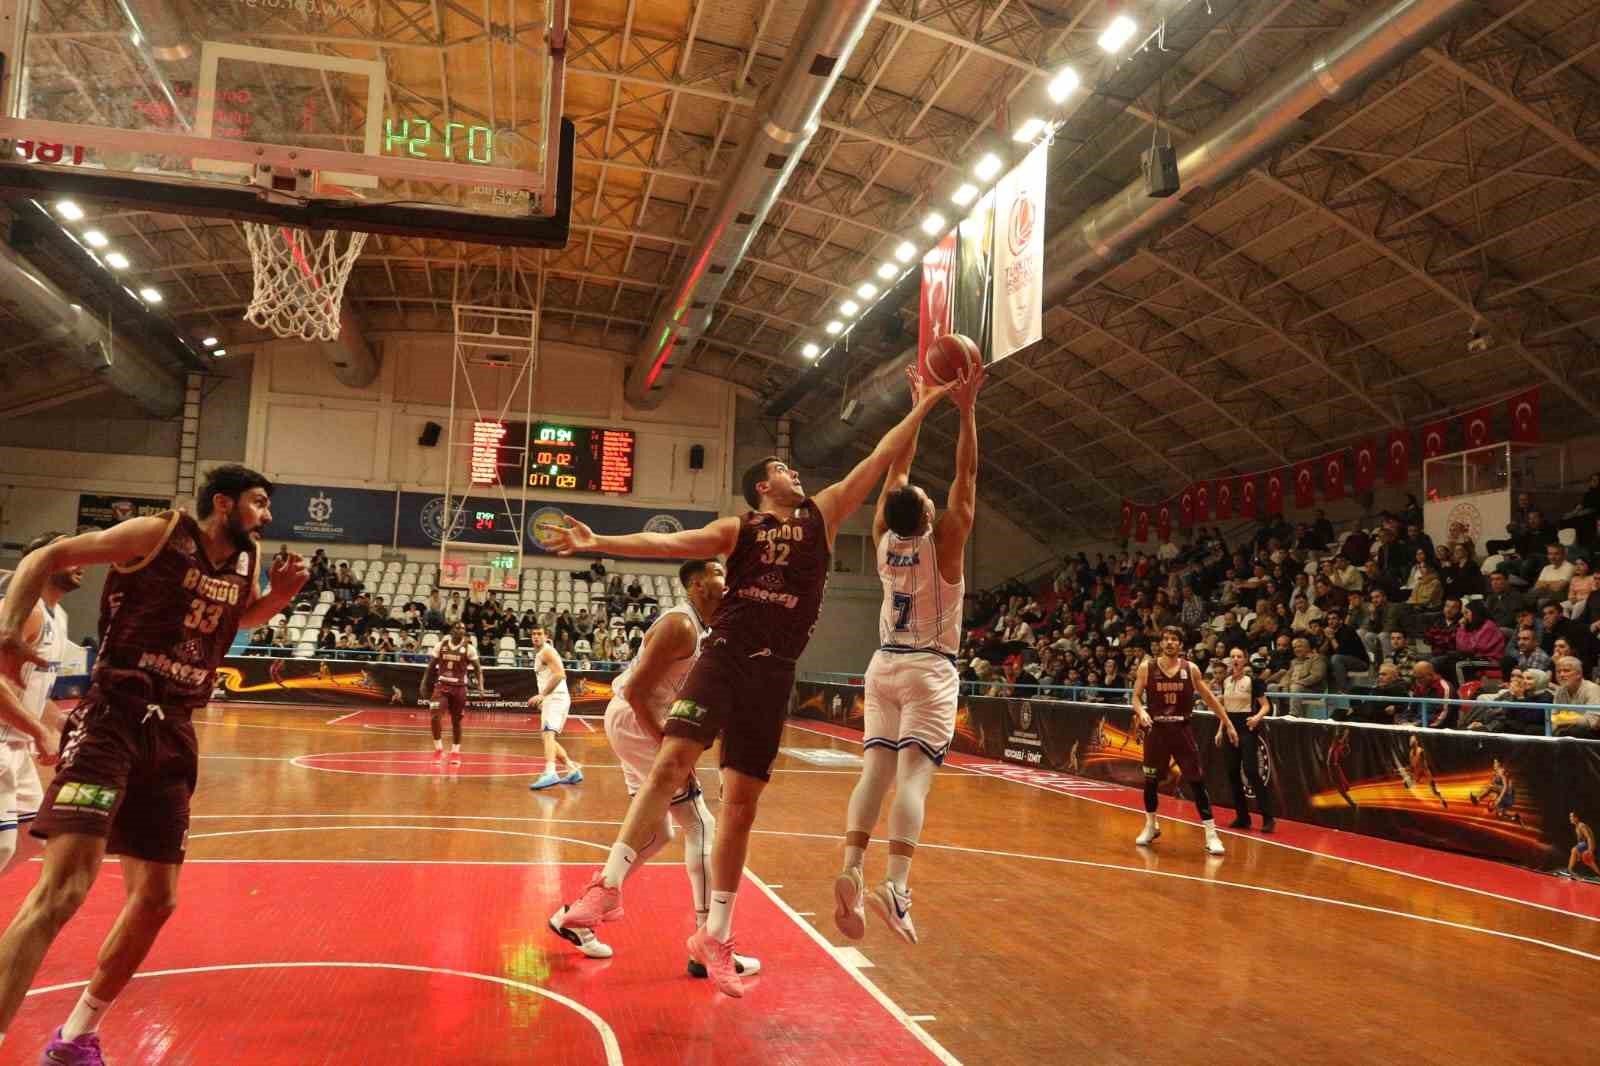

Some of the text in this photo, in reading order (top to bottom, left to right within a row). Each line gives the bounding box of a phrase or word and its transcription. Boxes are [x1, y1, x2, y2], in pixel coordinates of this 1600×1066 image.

[475, 519, 493, 529] 24
[760, 541, 790, 566] 32
[184, 599, 224, 634] 33
[892, 592, 912, 632] 7
[1164, 693, 1177, 704] 10
